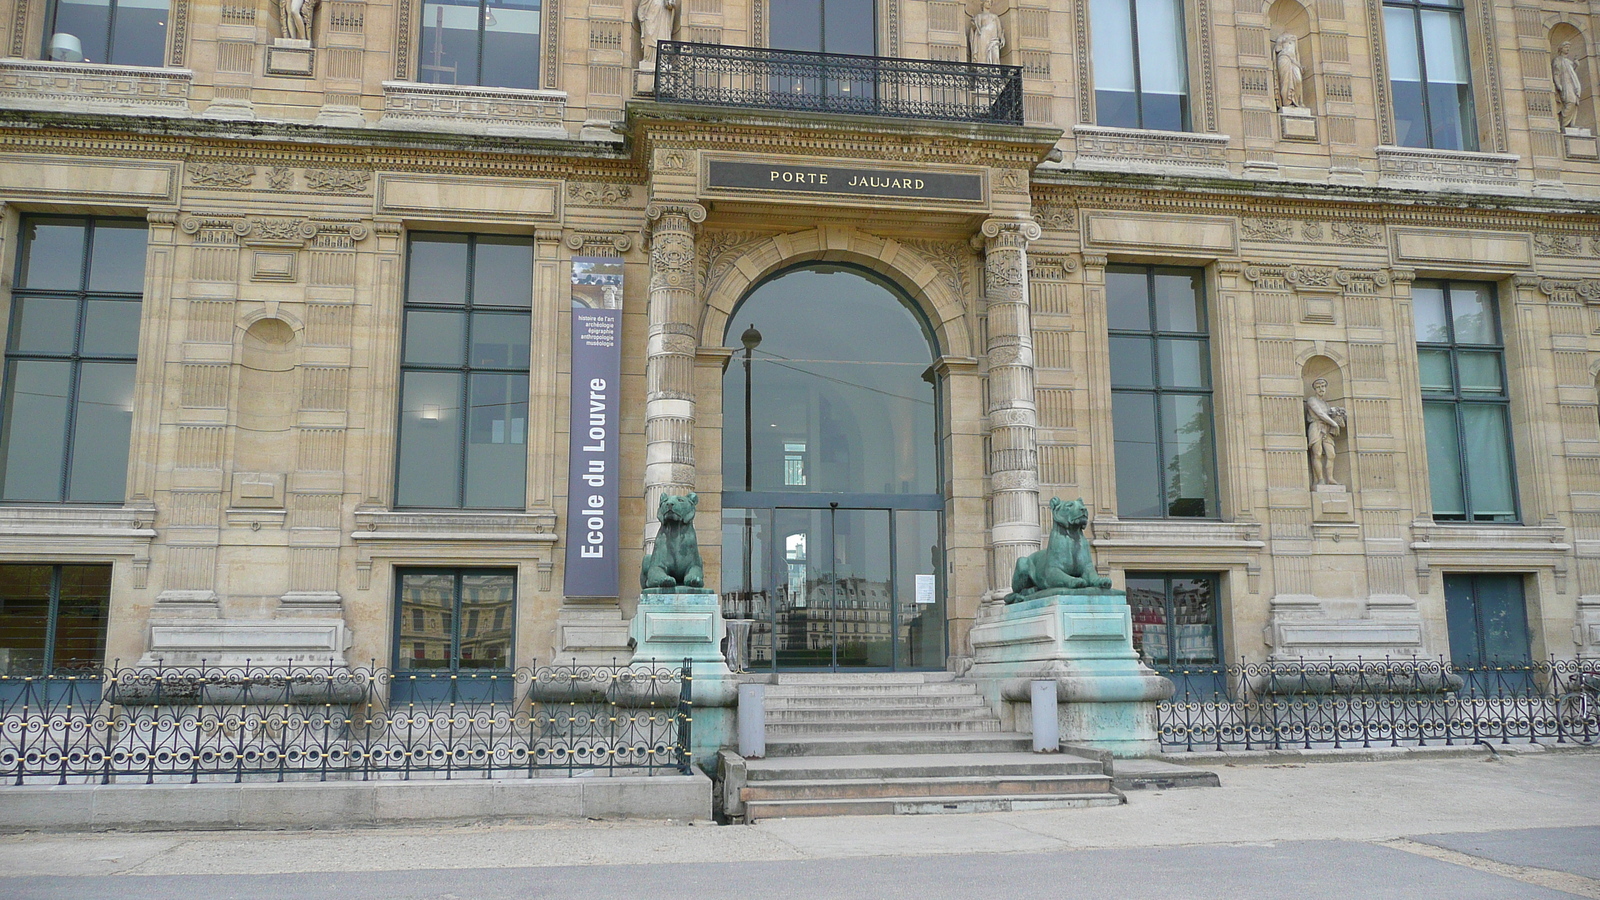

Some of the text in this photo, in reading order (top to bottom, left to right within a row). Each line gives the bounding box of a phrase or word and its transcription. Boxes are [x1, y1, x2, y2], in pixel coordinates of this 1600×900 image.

[770, 171, 925, 190] PORTE JAUJARD
[580, 378, 606, 558] Ecole du Louvre
